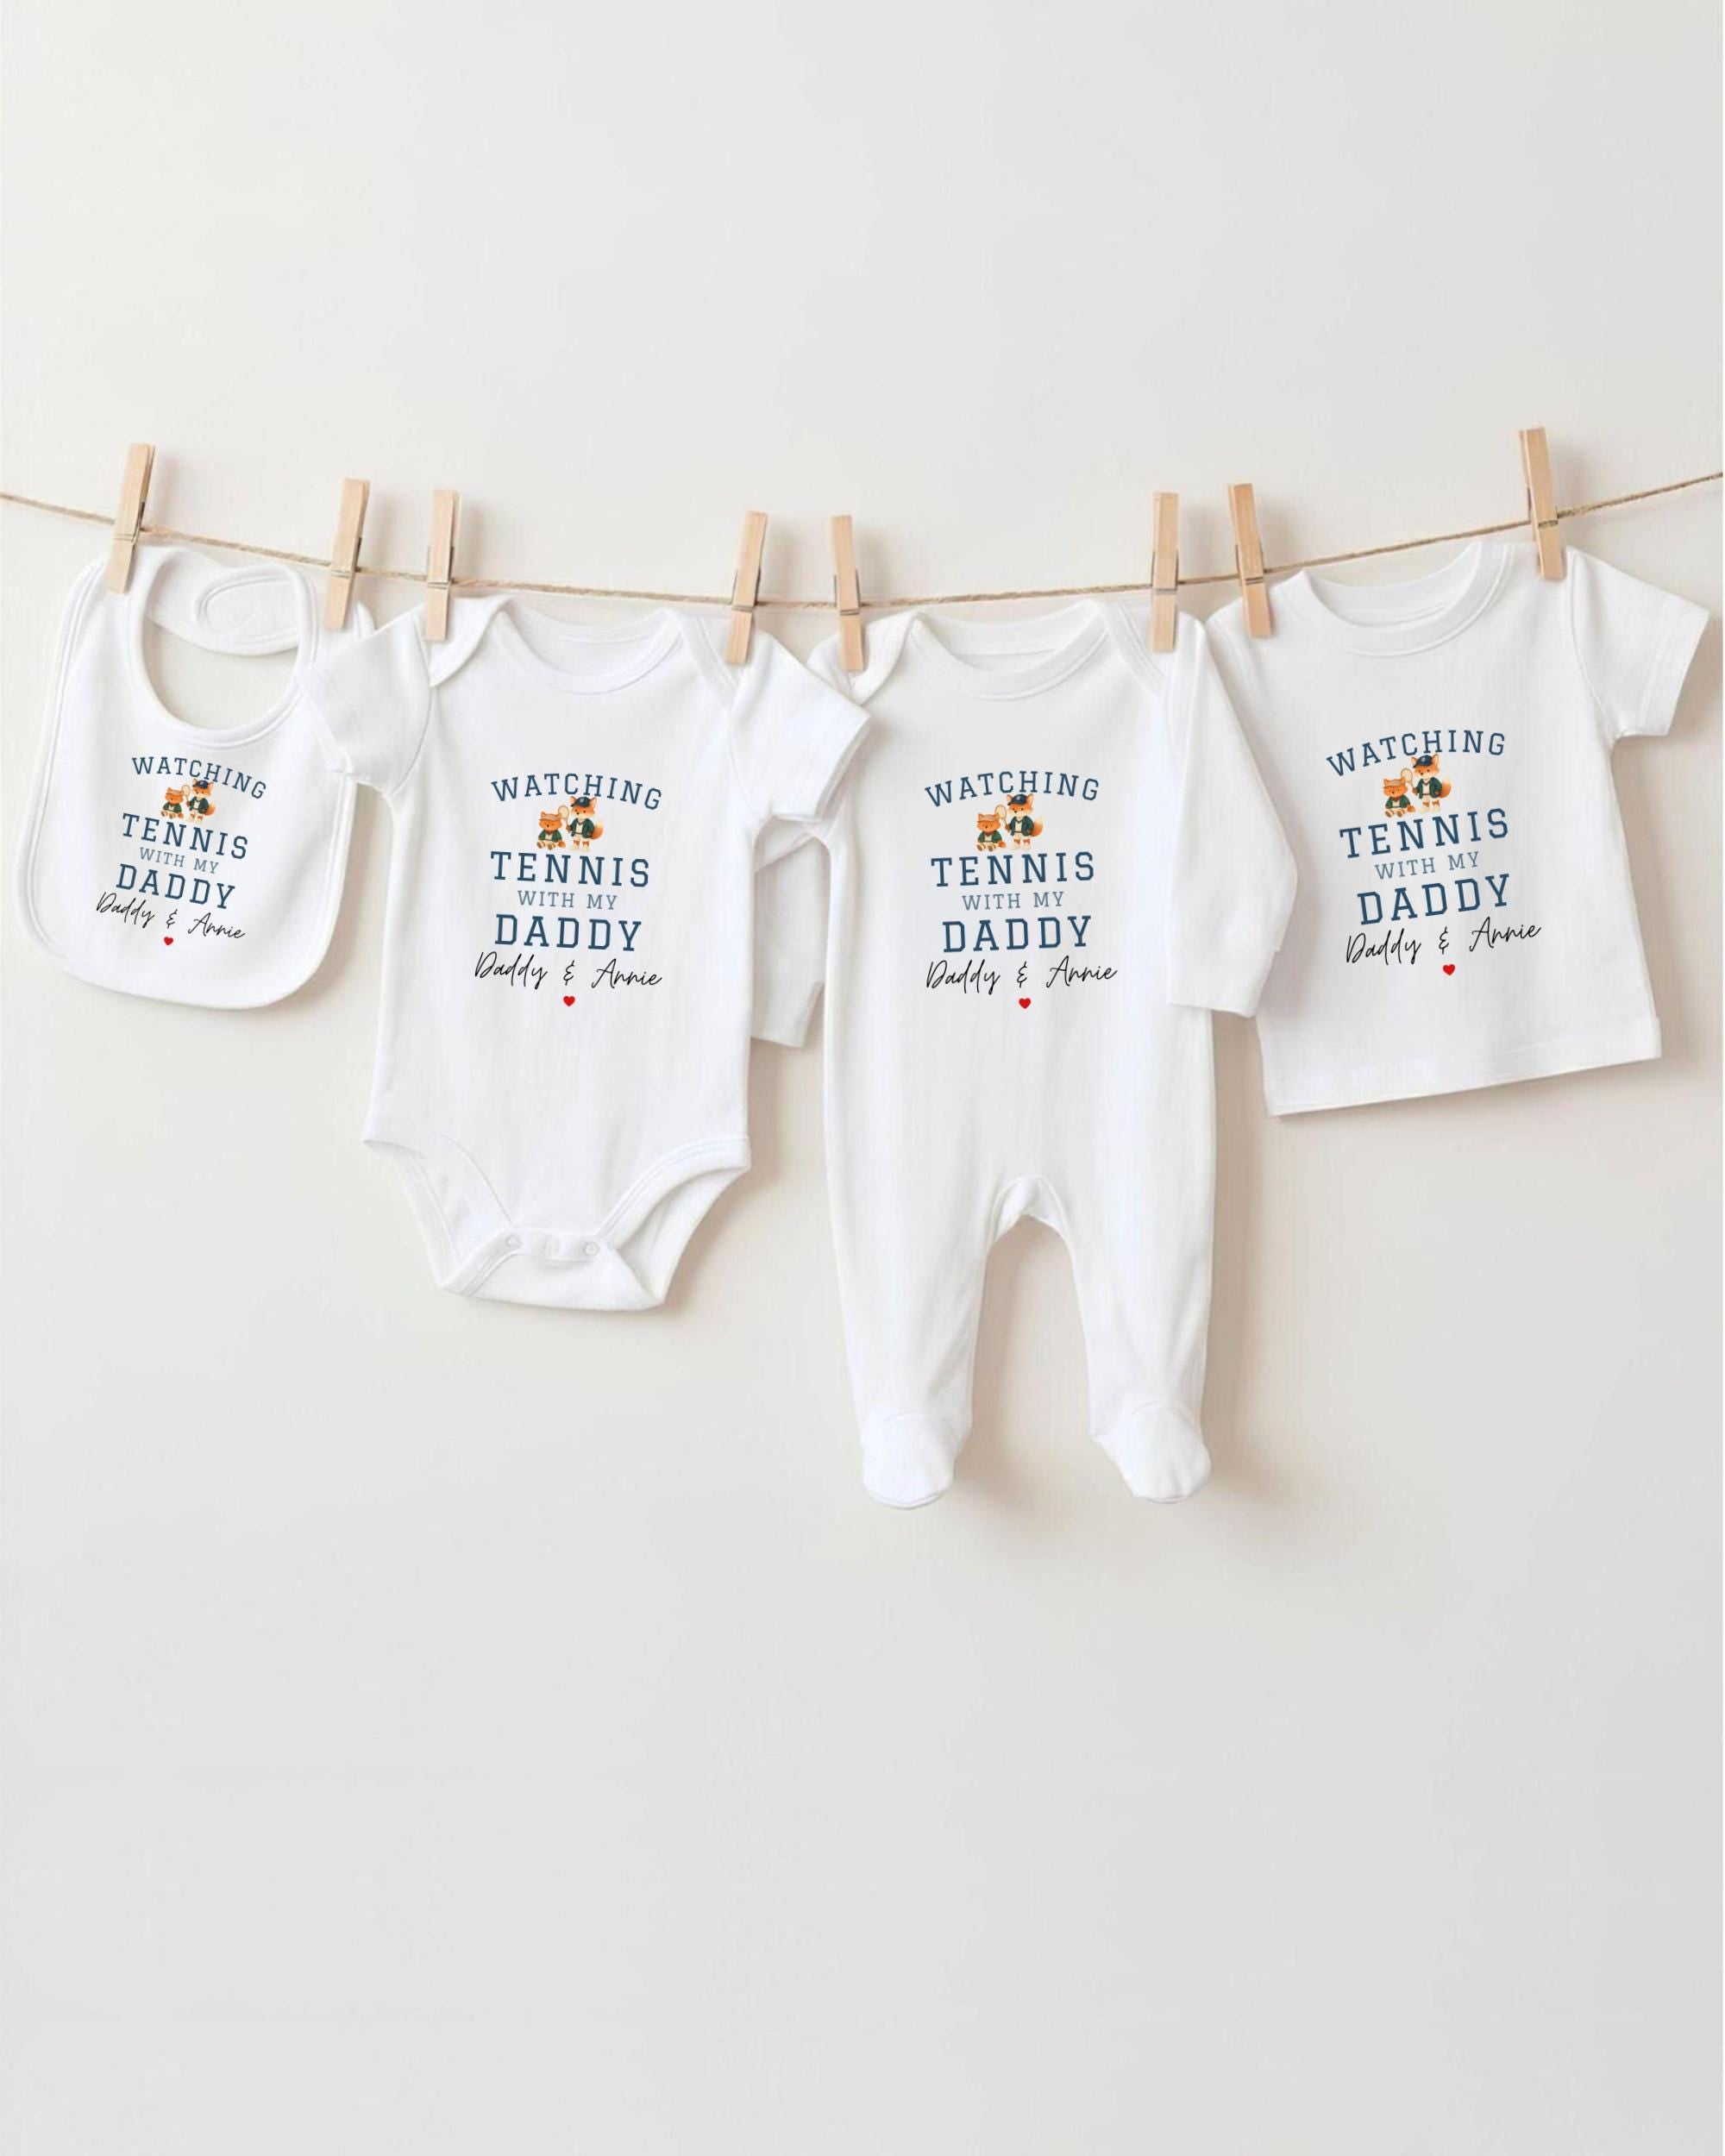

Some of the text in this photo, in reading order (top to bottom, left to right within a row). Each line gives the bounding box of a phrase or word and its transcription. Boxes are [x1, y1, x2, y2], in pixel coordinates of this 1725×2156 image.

[1327, 730, 1505, 776] WATCHING
[132, 756, 266, 799] WATCHING
[491, 774, 662, 810] WATCHING
[925, 771, 1099, 807] WATCHING
[122, 812, 248, 859] TENNIS
[1339, 808, 1509, 858] TENNIS
[140, 847, 219, 874] WITH MY
[491, 851, 649, 887] TENNIS
[931, 851, 1094, 887] TENNIS
[1375, 851, 1479, 880] WITH MY
[116, 863, 235, 909] DADDY
[518, 891, 618, 910] WITH MY
[962, 892, 1063, 911] WITH MY
[1357, 874, 1509, 924] DADDY
[97, 892, 246, 938] Daddy & Annie
[495, 914, 642, 951] DADDY
[943, 916, 1091, 952] DADDY
[1346, 917, 1541, 965] Daddy & Annie
[474, 951, 662, 989] Daddy & Annie
[925, 956, 1118, 994] Daddy & Annie
